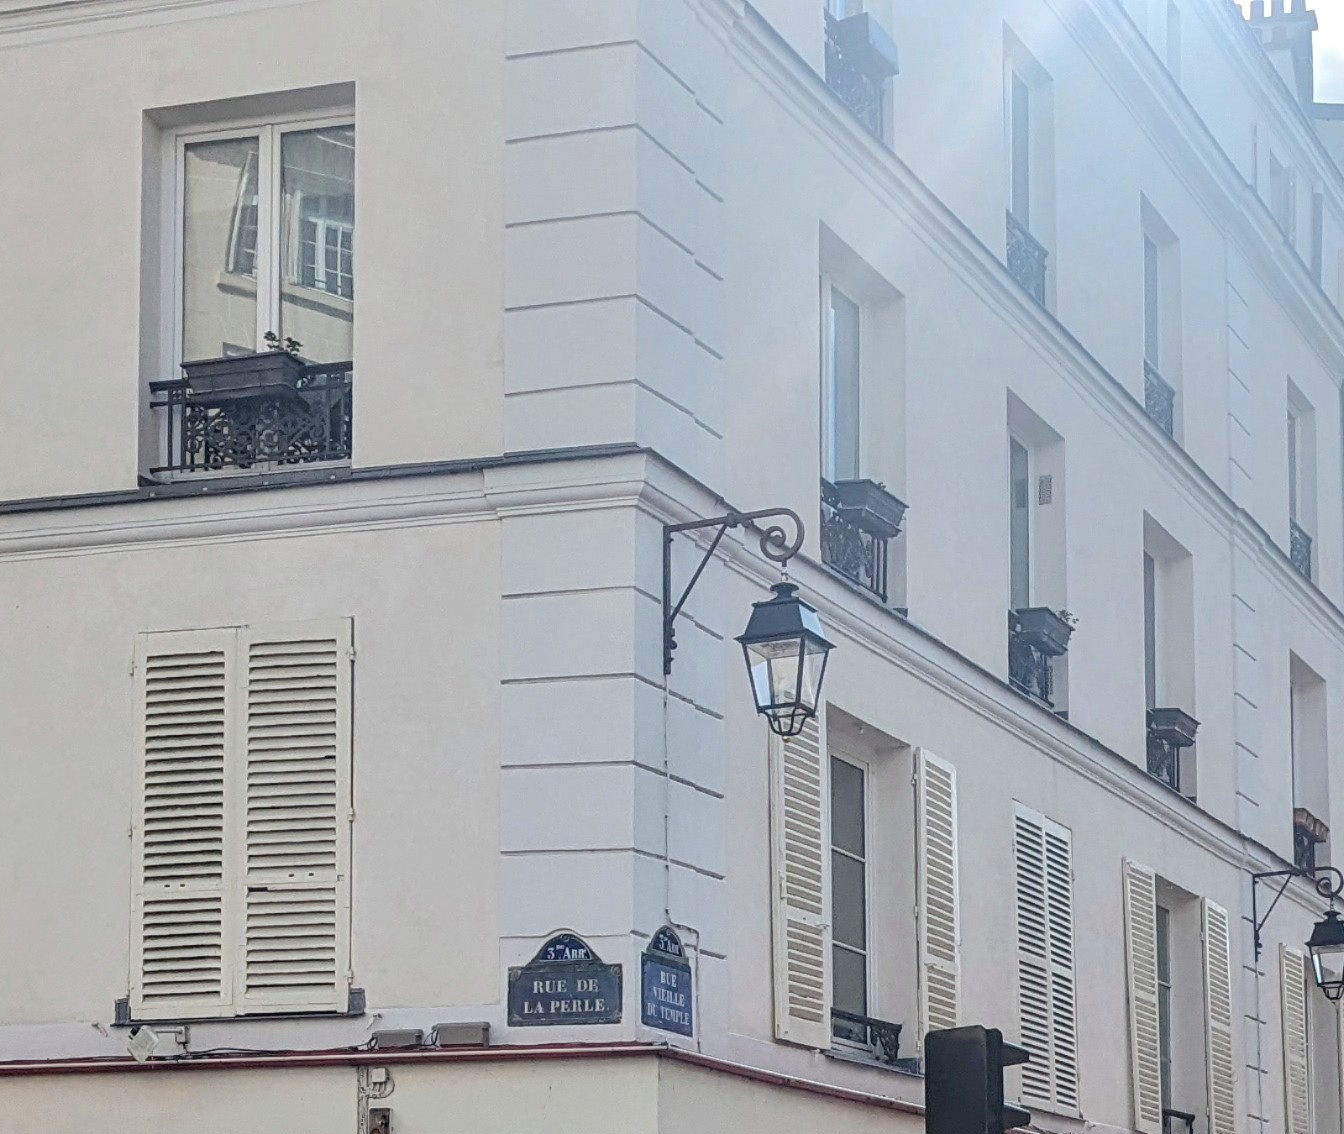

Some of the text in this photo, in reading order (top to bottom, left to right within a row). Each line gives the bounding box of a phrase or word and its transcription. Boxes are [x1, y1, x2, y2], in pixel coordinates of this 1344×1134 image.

[533, 978, 599, 994] RUE DE
[660, 970, 677, 988] RUE
[653, 986, 685, 1007] VIEILLE
[523, 1000, 545, 1014] LA
[647, 1002, 690, 1026] DU TEMPLE
